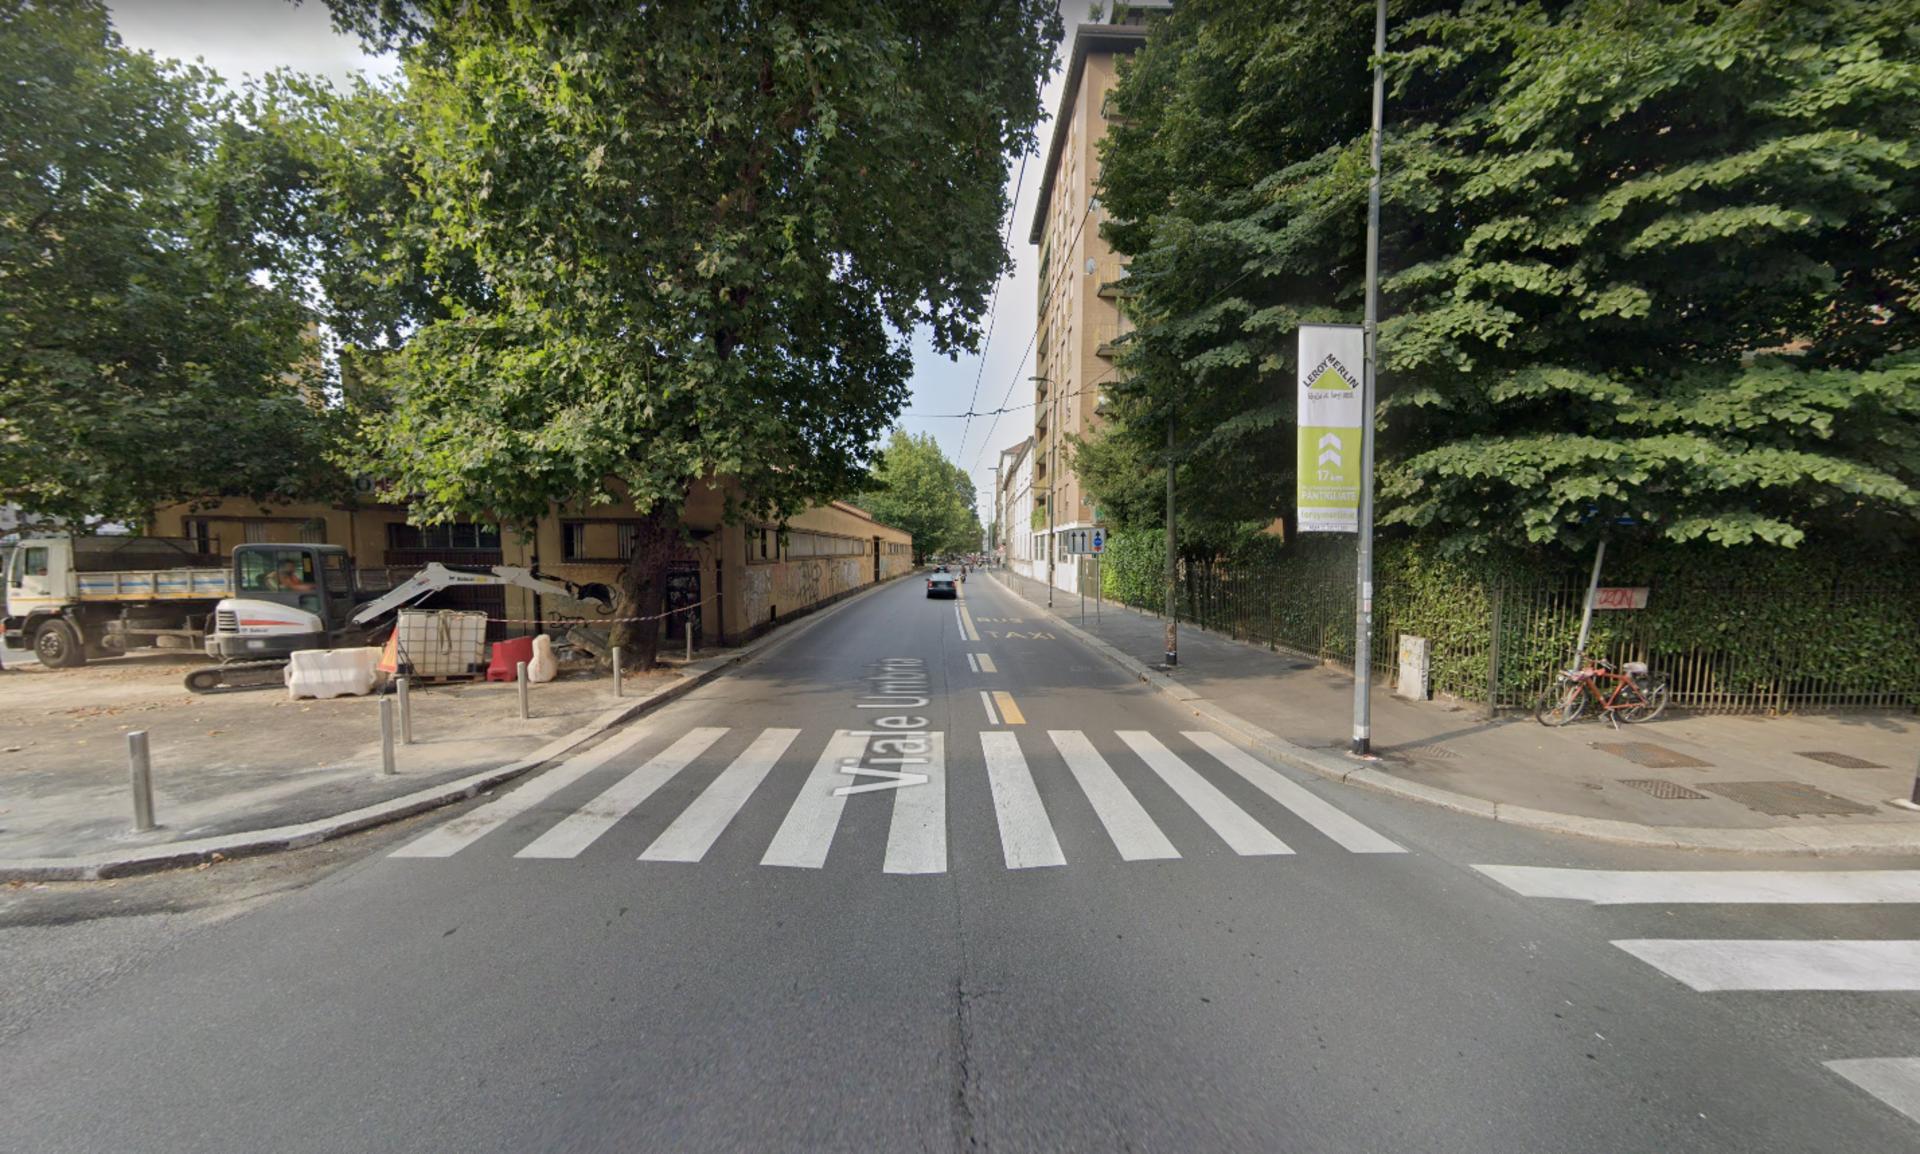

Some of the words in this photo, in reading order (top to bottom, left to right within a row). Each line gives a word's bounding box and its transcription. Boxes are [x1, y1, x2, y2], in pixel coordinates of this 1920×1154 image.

[1303, 360, 1328, 387] LEROY
[1326, 353, 1359, 389] MERLIN
[1317, 469, 1329, 481] 17
[984, 631, 1056, 639] TAXI
